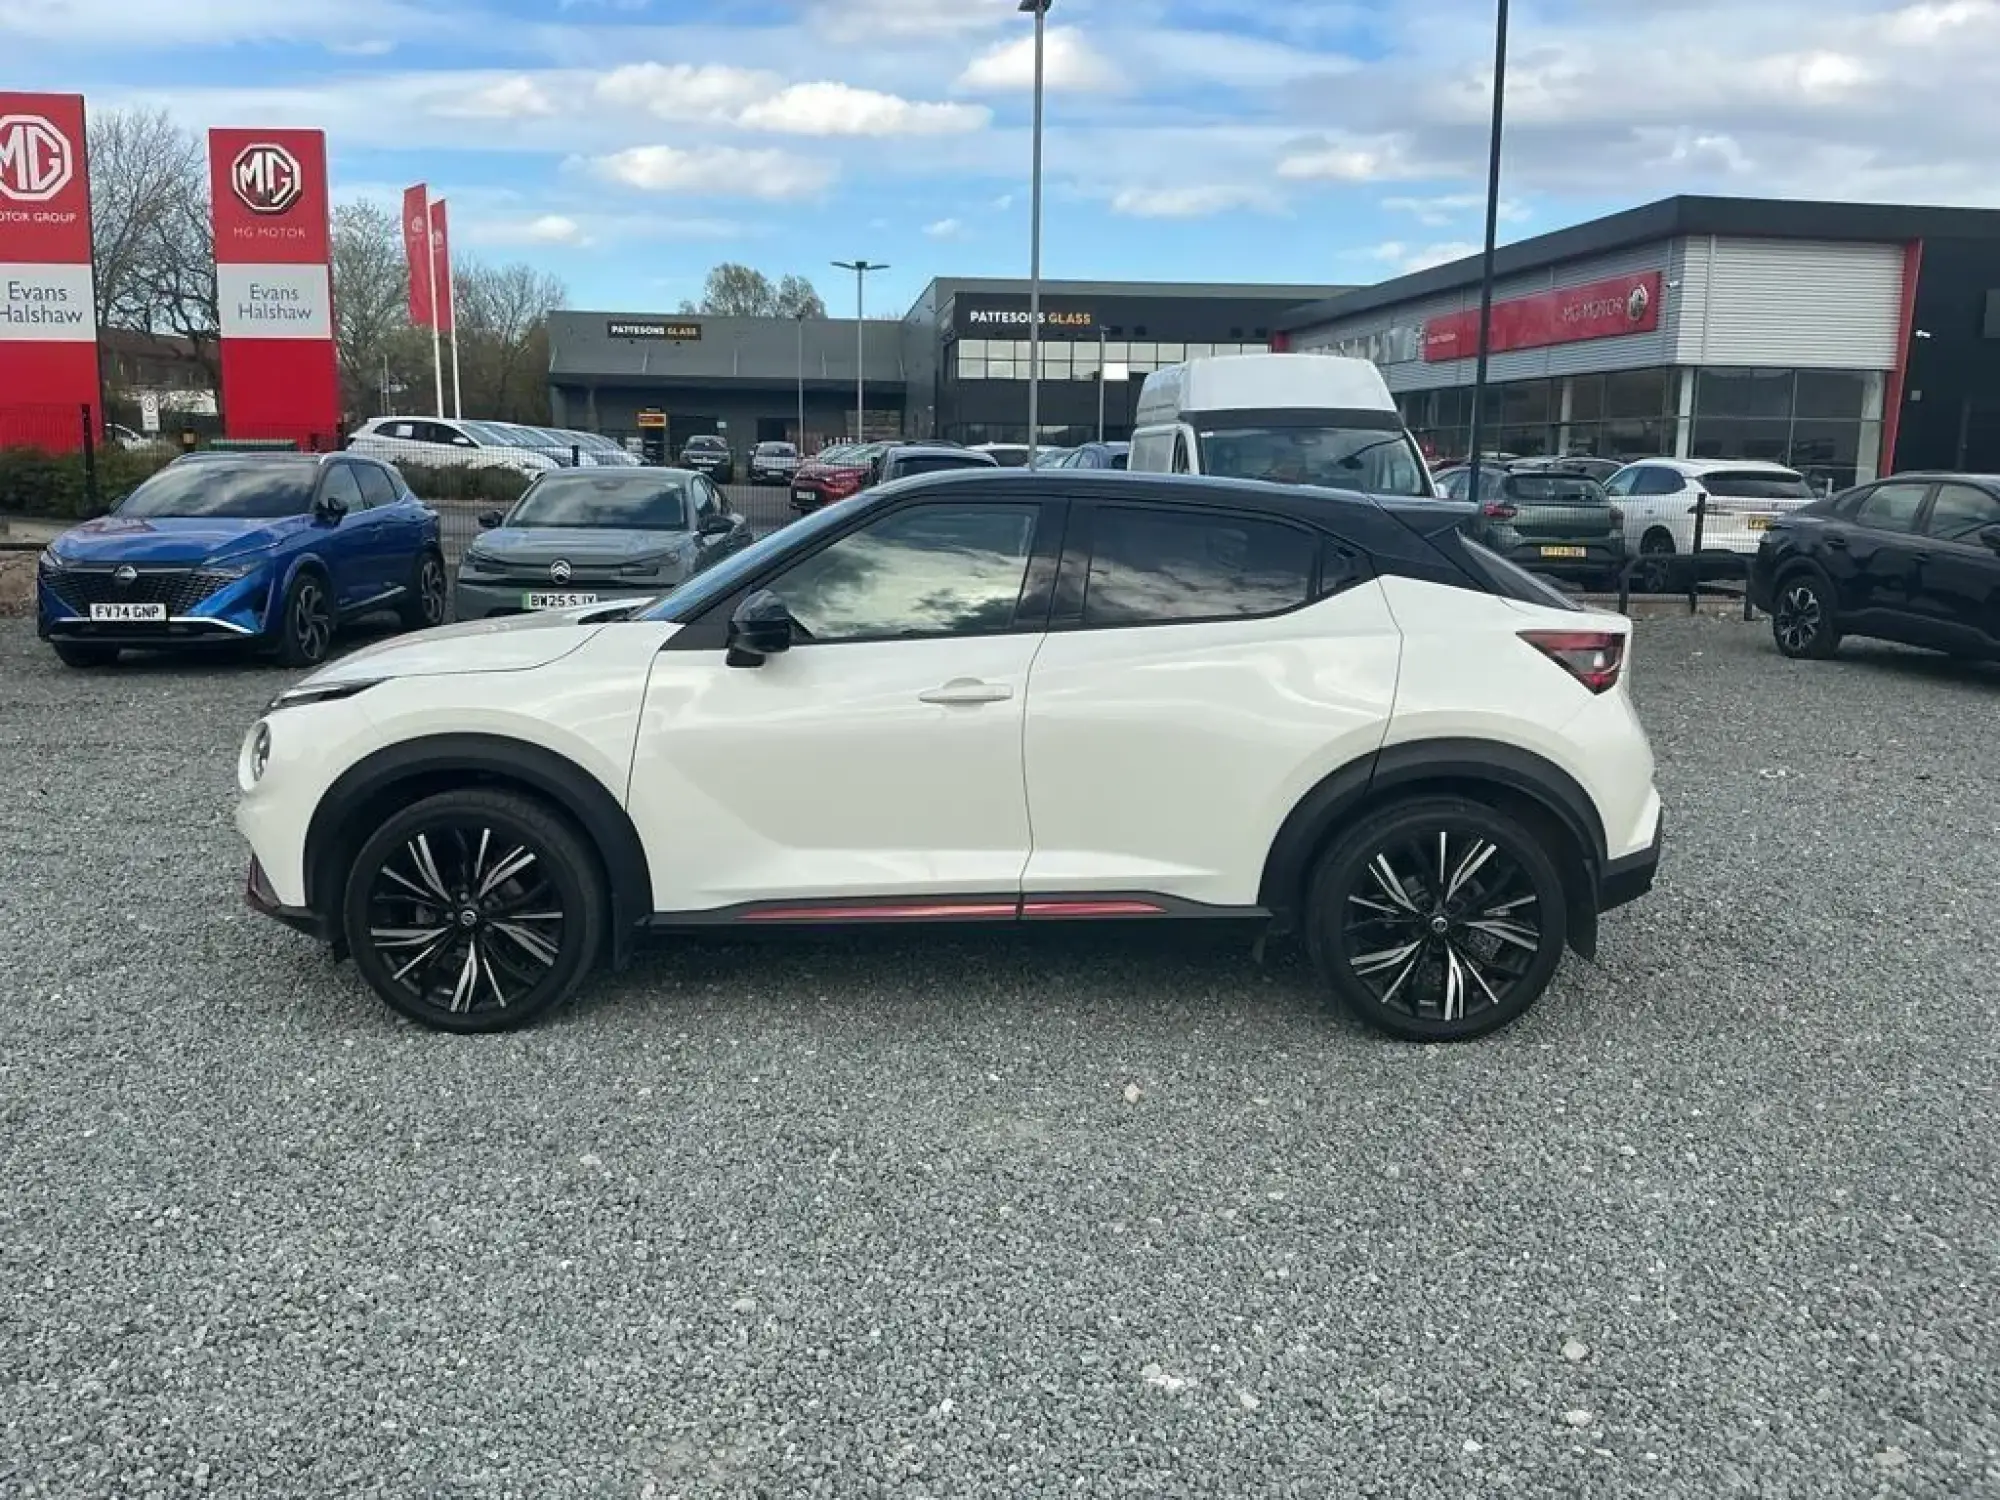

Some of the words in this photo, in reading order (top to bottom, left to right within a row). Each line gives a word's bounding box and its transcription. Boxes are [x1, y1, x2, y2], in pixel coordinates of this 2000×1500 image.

[240, 151, 292, 204] MG
[33, 212, 76, 221] GROUP
[234, 227, 253, 238] MG
[258, 227, 306, 238] MOTOR
[9, 281, 67, 301] Evans
[250, 283, 299, 301] Evans
[0, 304, 83, 323] Halshaw
[238, 302, 312, 320] Halshaw
[970, 311, 1045, 323] PATTESOS
[1048, 312, 1091, 325] GLASS
[667, 327, 697, 335] GLASS
